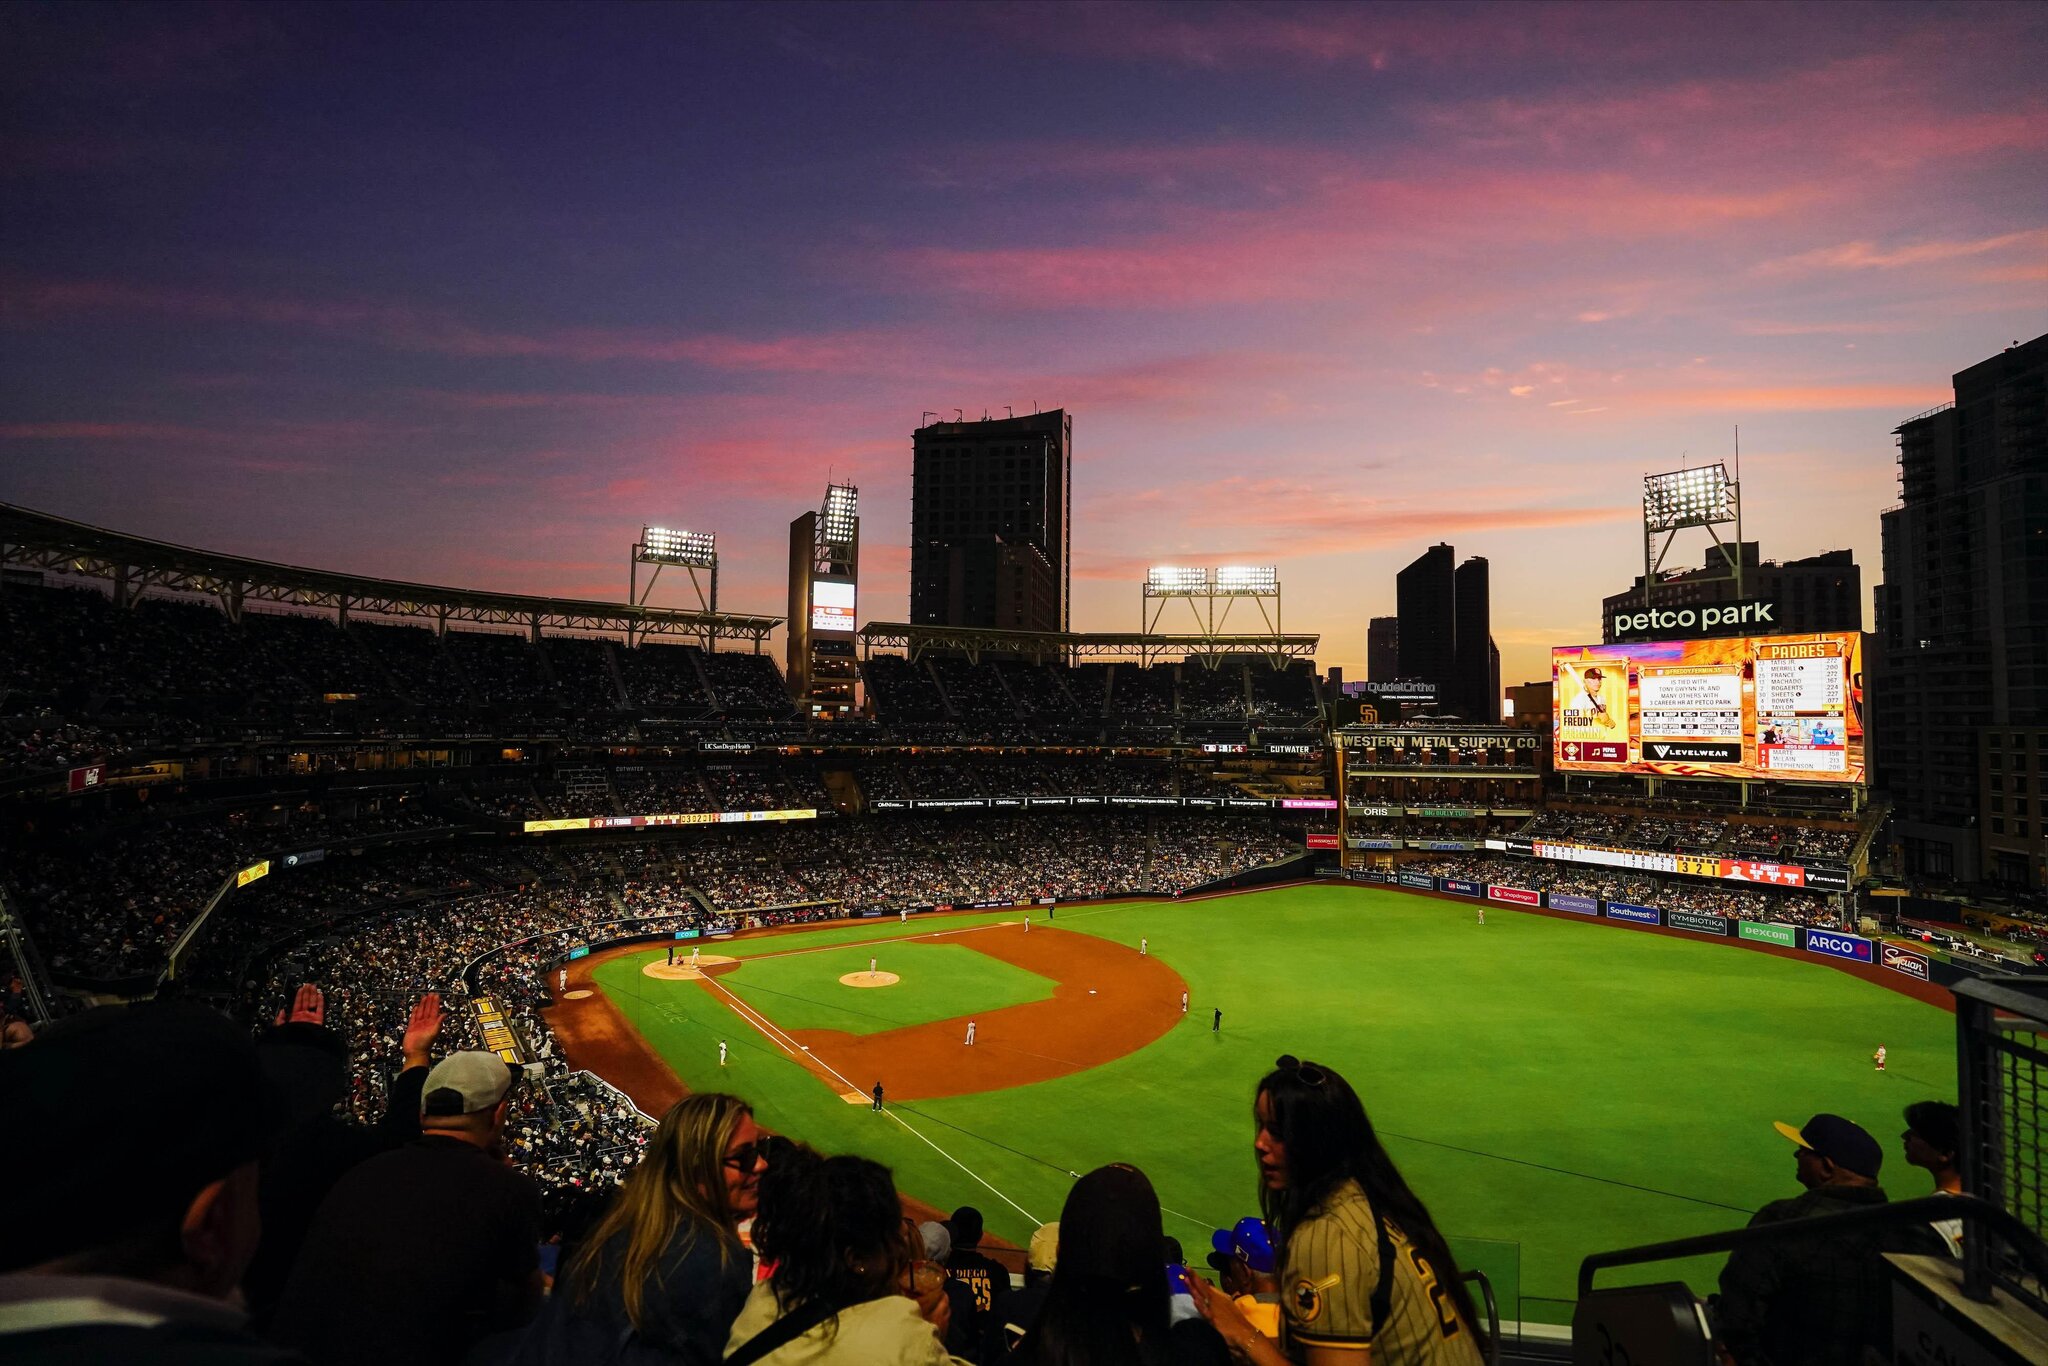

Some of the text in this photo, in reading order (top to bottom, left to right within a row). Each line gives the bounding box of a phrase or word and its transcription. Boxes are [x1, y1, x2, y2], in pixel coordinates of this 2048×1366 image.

[1615, 602, 1774, 637] petco park
[1771, 644, 1825, 659] PADRES
[1367, 682, 1436, 694] QuidelOrtho
[1563, 717, 1594, 727] FREDDY
[1343, 735, 1541, 749] WESTERN METAL SUPPLY CO.
[1270, 745, 1309, 753] CUTWATER
[1669, 749, 1728, 757] LEVELWEAR
[1364, 808, 1388, 816] ORIS
[1682, 861, 1716, 876] 3 2 1
[1386, 875, 1398, 883] 342
[1409, 875, 1431, 884] Palomar
[1814, 876, 1846, 884] LEVELWEAR
[1456, 883, 1472, 891] bank
[1503, 891, 1534, 901] Snapdragon
[1559, 899, 1595, 910] QuidelOrtho
[1610, 906, 1651, 919] Southwest
[1670, 914, 1724, 928] CYMBIOTIKA
[1808, 935, 1853, 954] ARCO
[574, 950, 585, 958] COX
[1885, 948, 1923, 972] Sycuan
[956, 1269, 987, 1278] DIEGO
